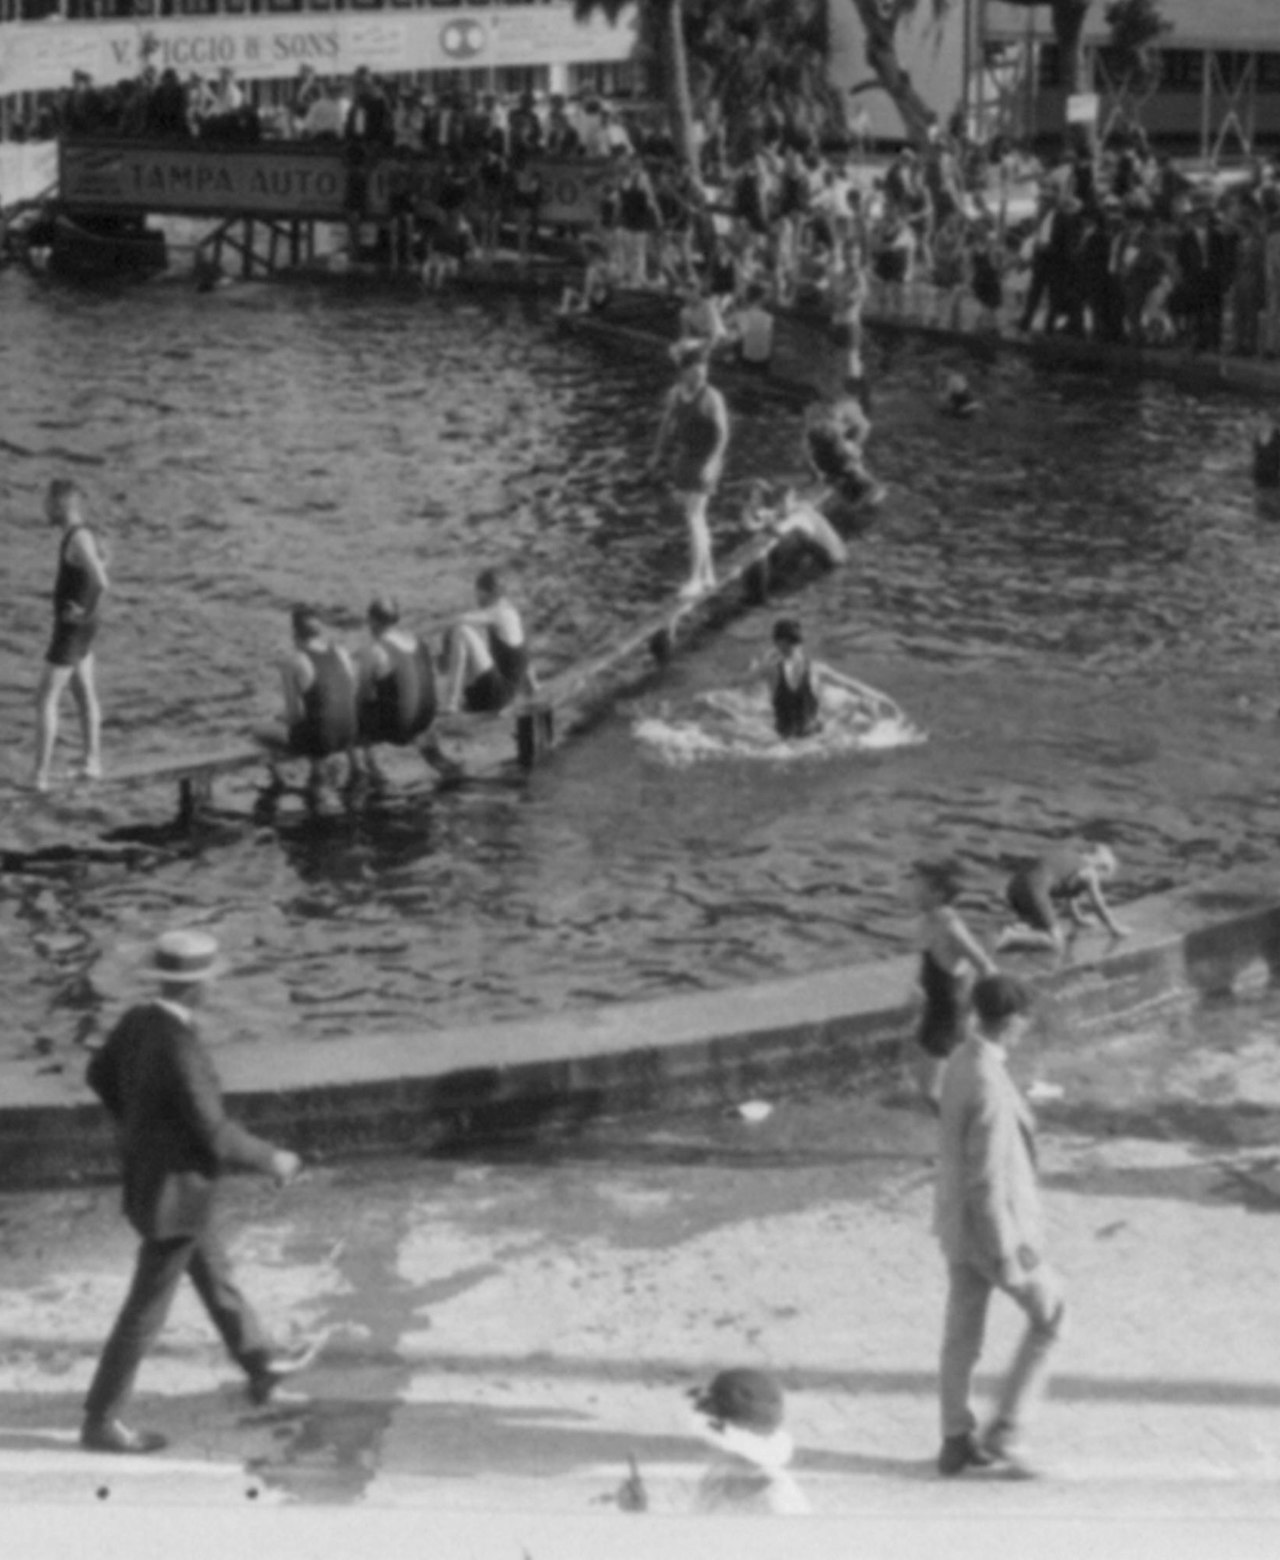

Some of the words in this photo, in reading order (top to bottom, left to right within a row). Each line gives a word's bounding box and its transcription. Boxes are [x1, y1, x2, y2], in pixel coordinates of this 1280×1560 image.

[141, 36, 235, 65] ICCIO
[273, 31, 340, 59] SONS
[130, 164, 235, 192] TAMPA
[251, 170, 338, 197] AUTO
